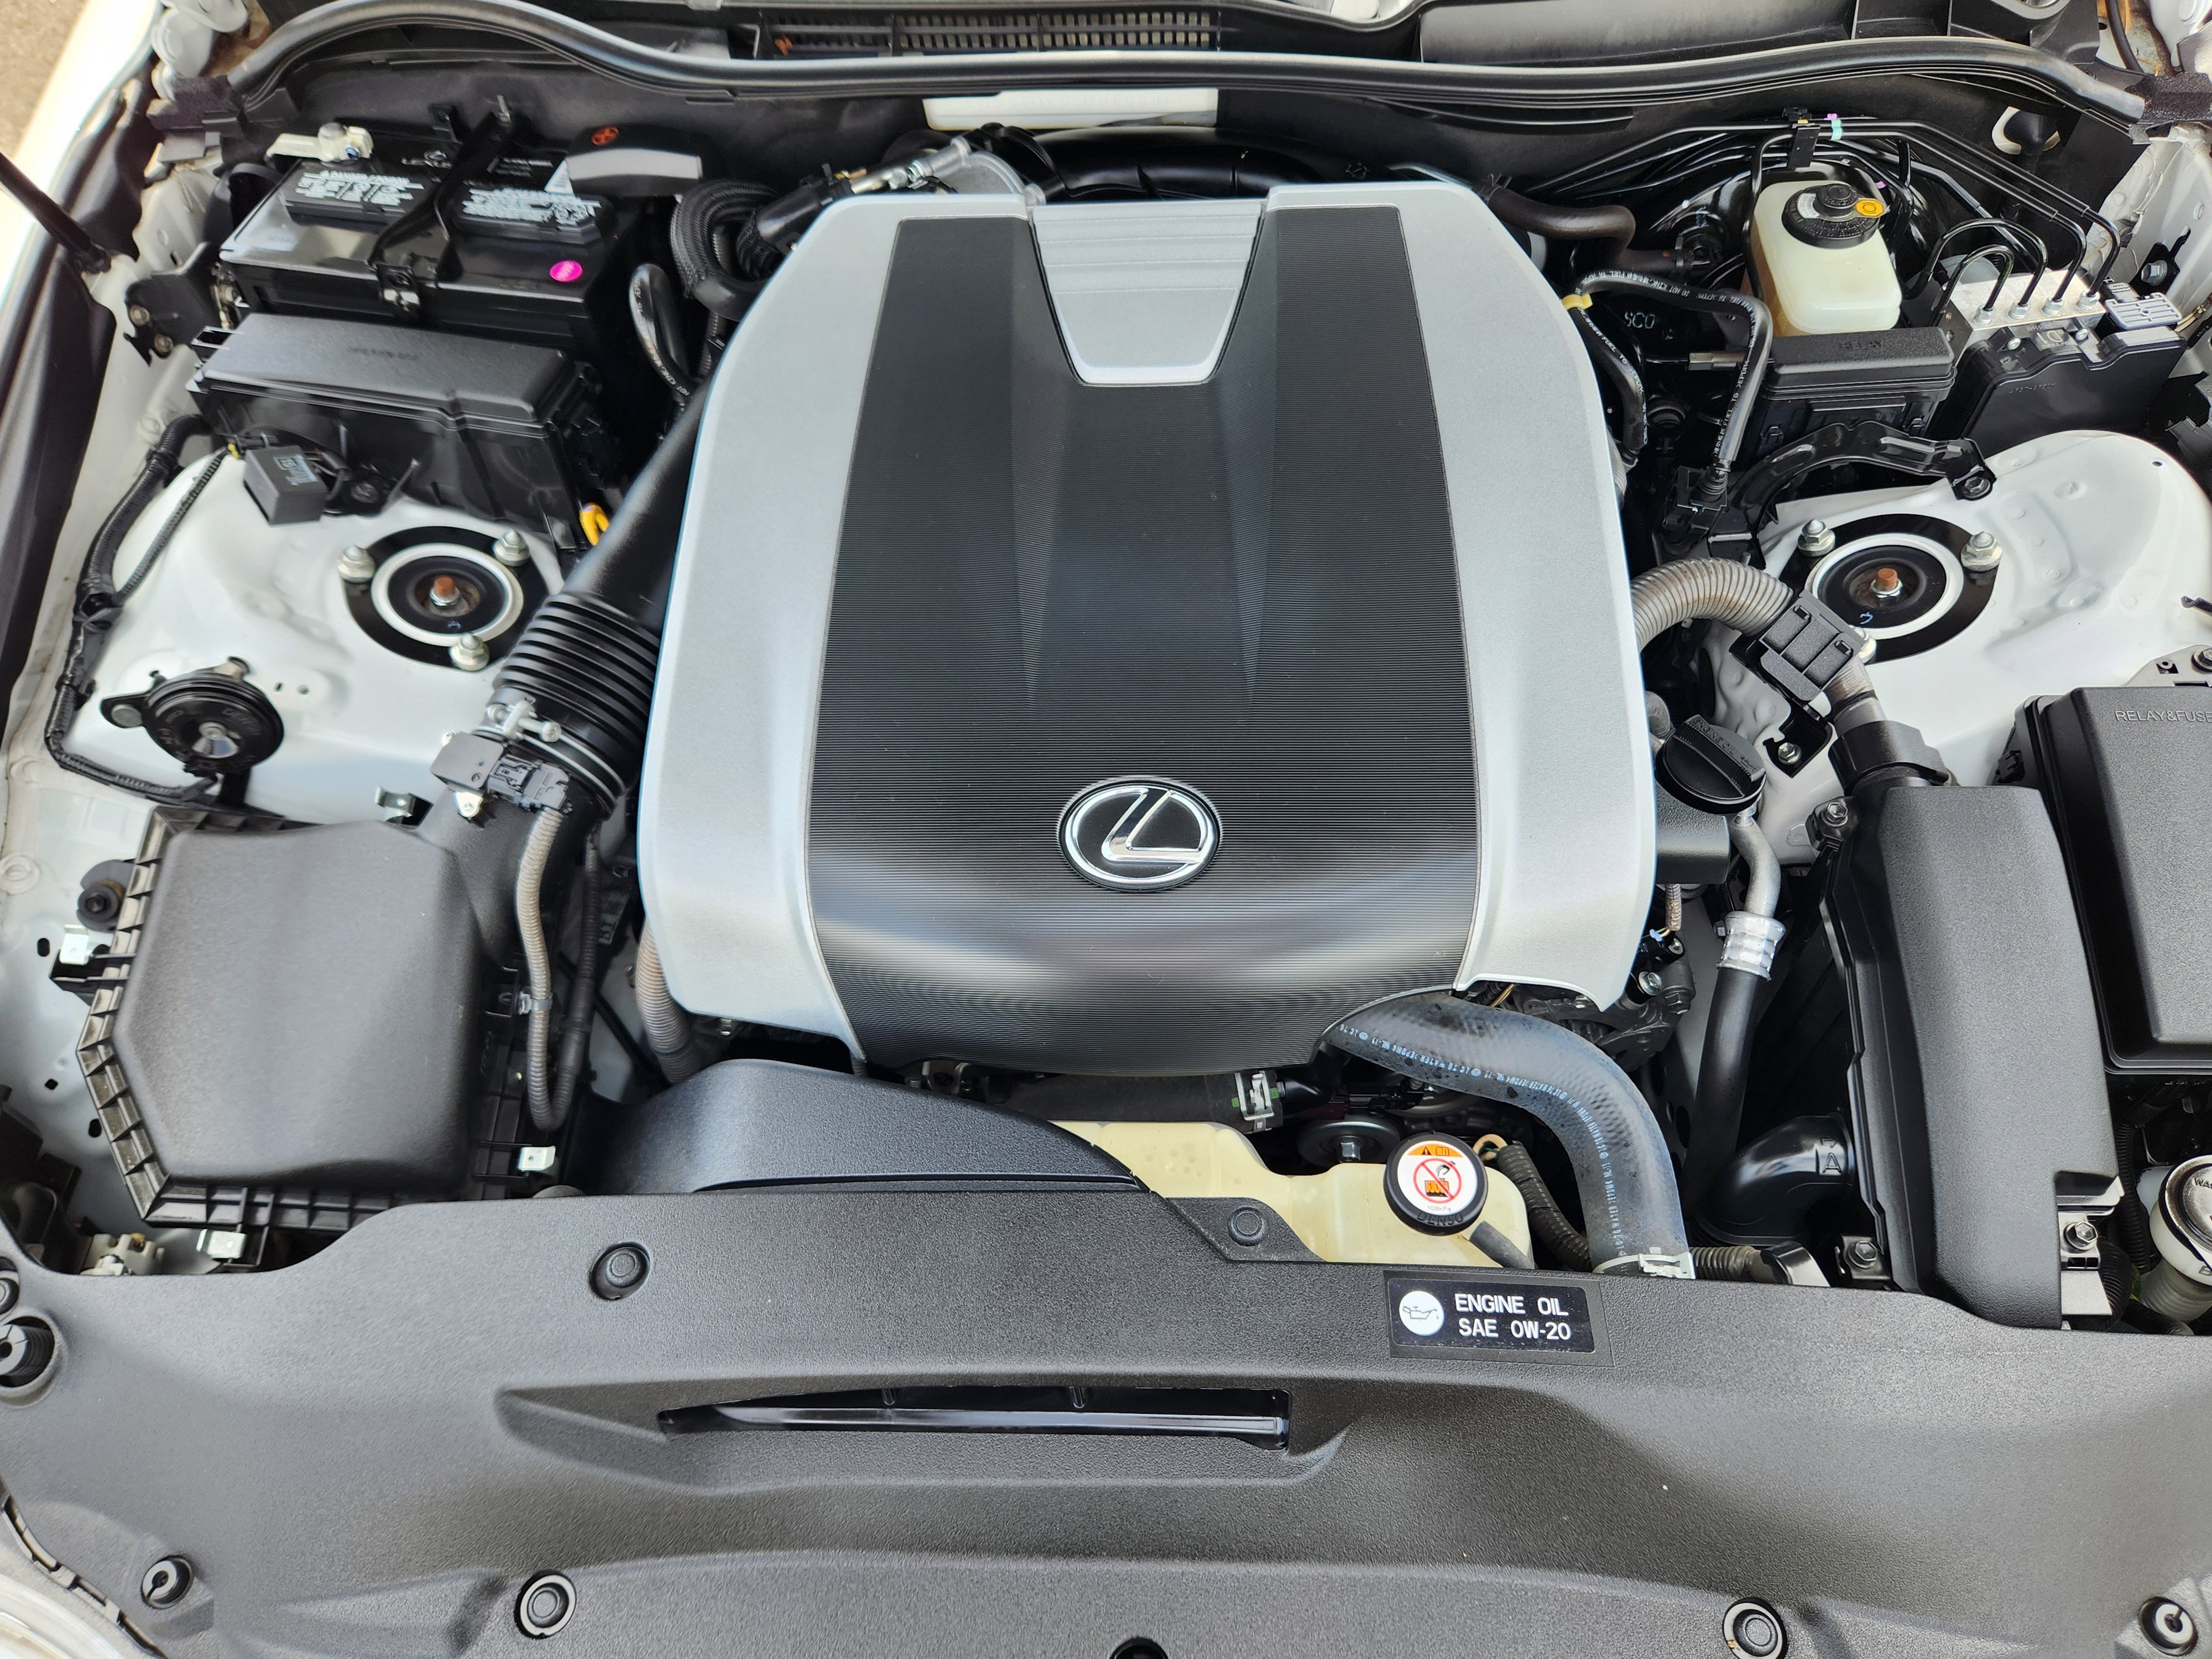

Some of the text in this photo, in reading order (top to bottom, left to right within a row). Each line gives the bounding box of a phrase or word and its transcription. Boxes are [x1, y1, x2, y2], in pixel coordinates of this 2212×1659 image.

[1609, 270, 1625, 279] FUEL
[1601, 336, 1617, 352] FUEL
[1619, 353, 1627, 365] TG
[1723, 408, 1734, 426] FUEL
[1731, 392, 1739, 403] TG
[1692, 718, 1735, 756] ENGINE OIL
[2194, 1177, 2212, 1190] WA
[1417, 1212, 1464, 1226] DENSO
[1454, 1293, 1569, 1316] ENGINE OIL
[1459, 1317, 1572, 1340] SAE 0W-20
